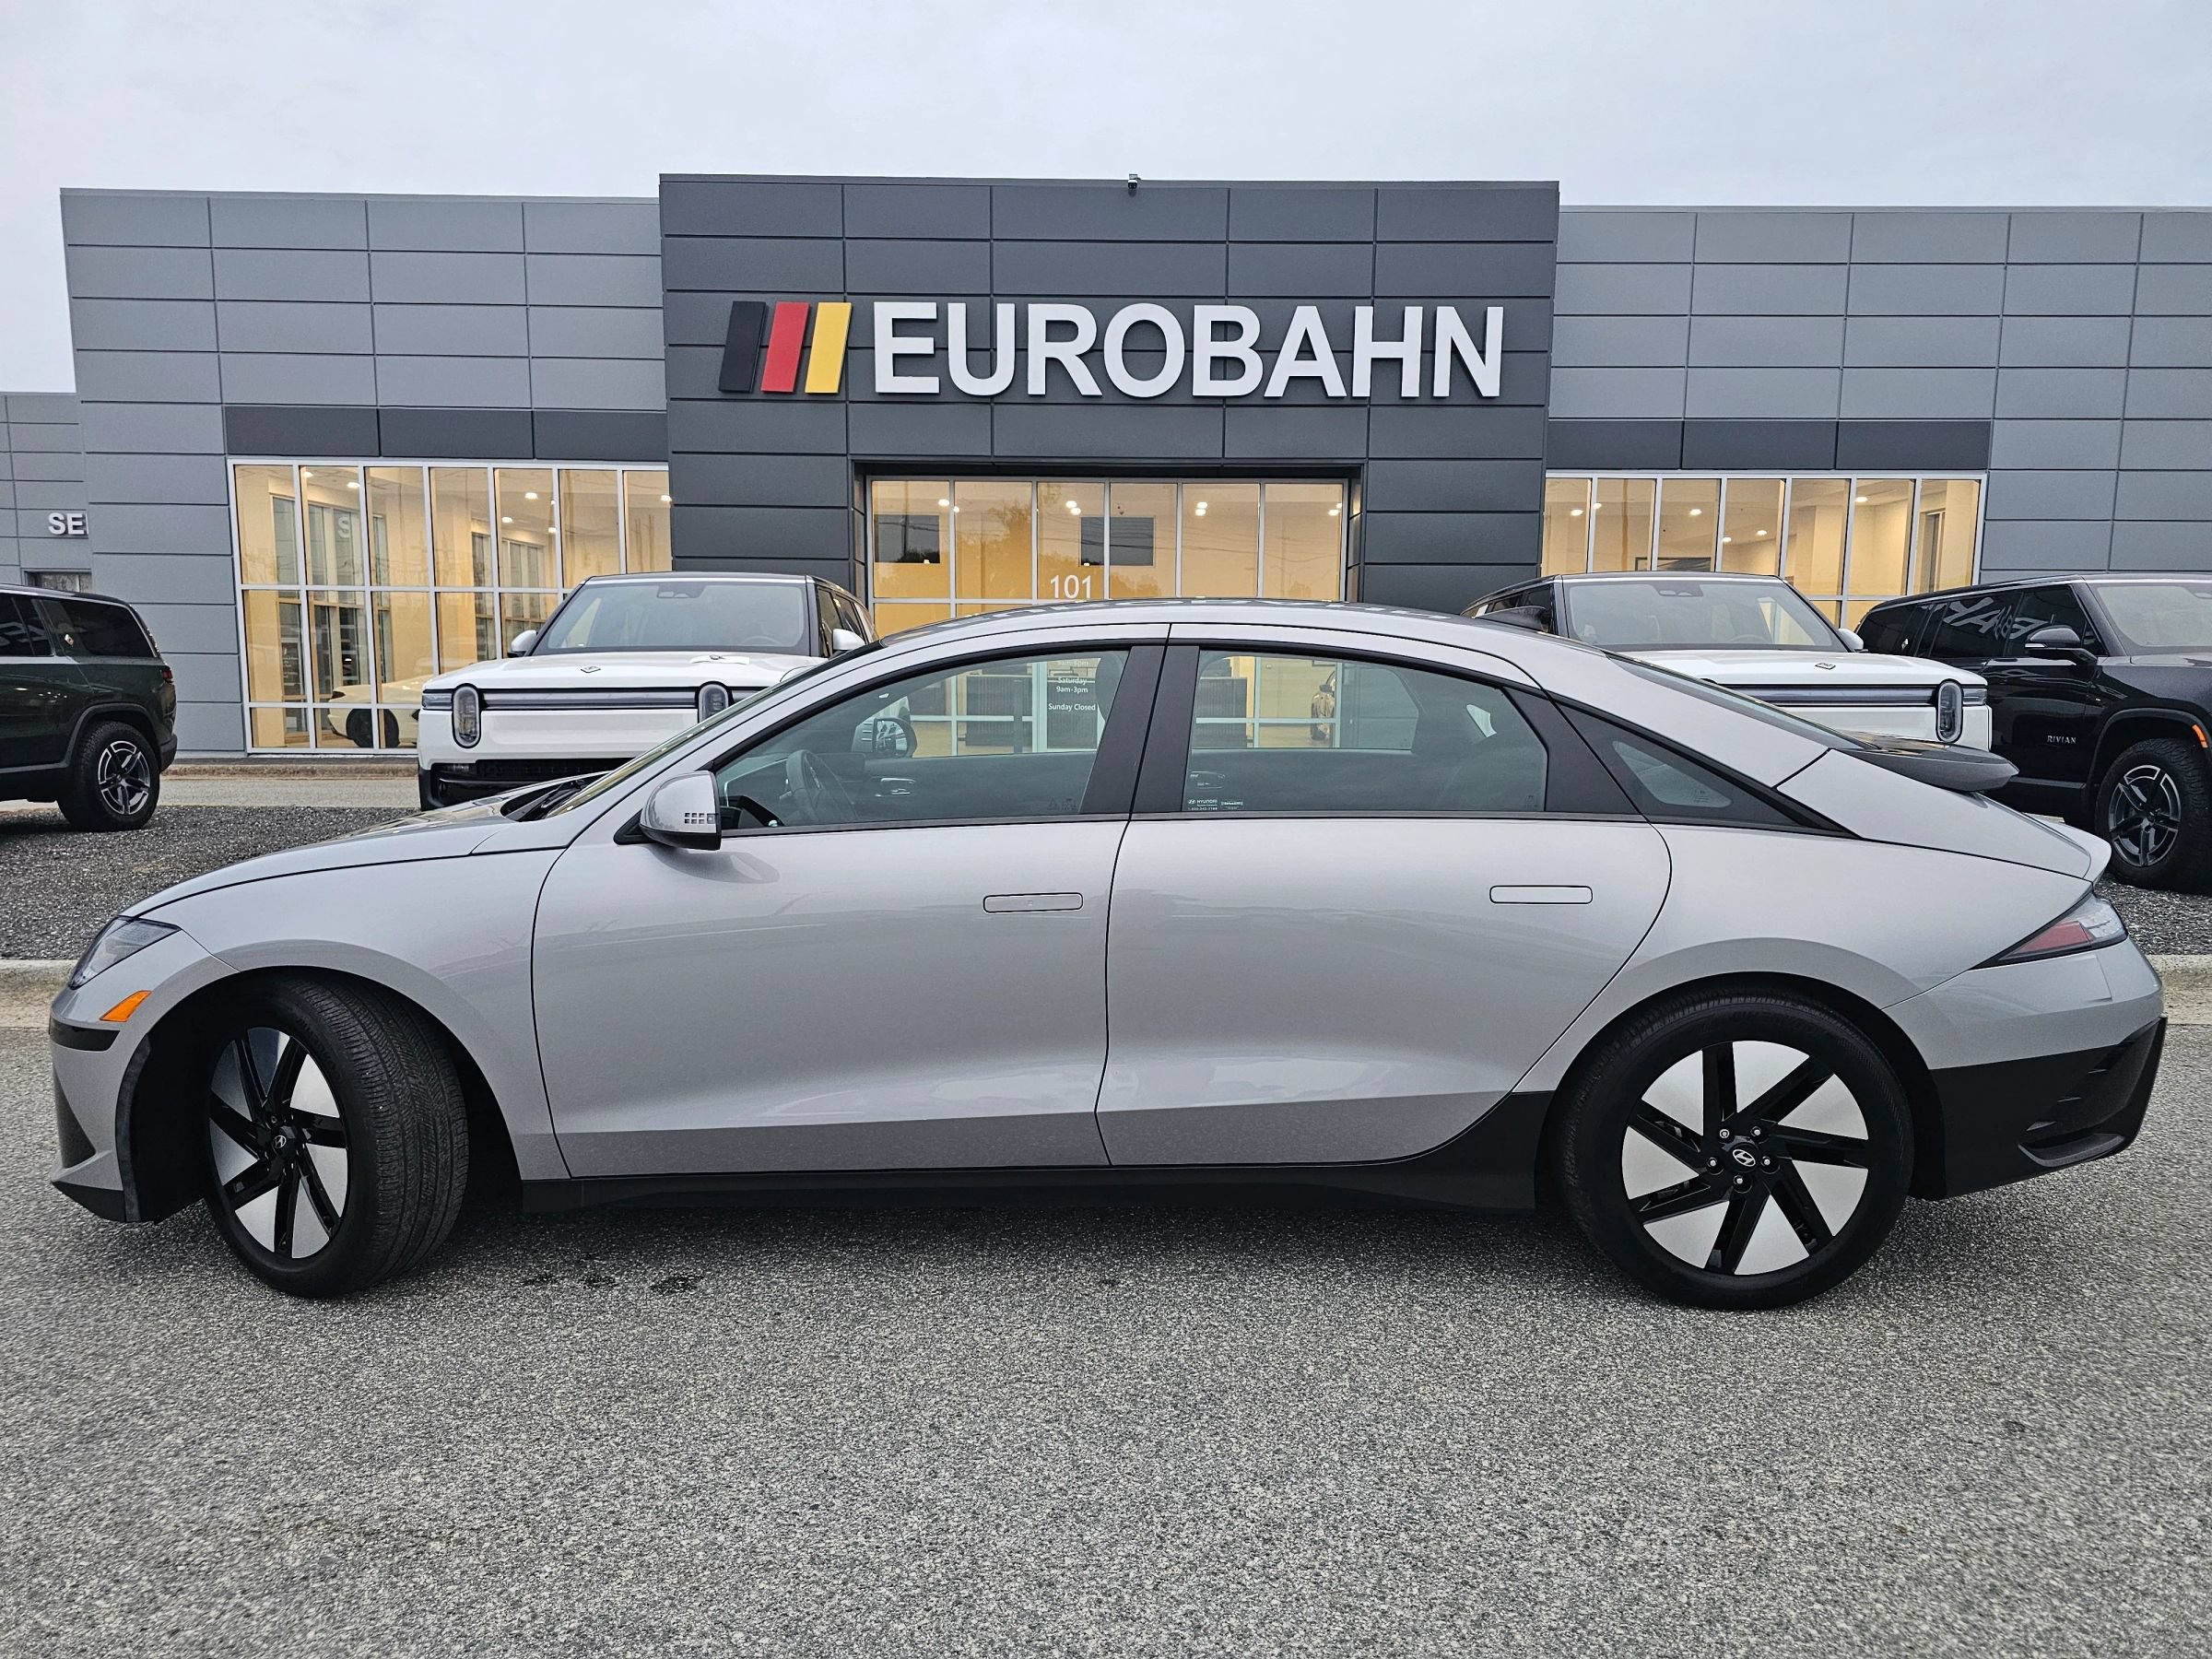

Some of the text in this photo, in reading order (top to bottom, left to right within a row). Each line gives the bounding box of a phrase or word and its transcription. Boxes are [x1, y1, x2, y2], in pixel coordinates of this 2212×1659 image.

[873, 301, 1505, 399] EUROBAHN
[48, 512, 89, 535] SE
[1050, 574, 1091, 599] 101
[1057, 677, 1088, 686] Saturday
[1055, 686, 1088, 694] 9am-3pm
[1048, 703, 1096, 712] Sunday Closed
[2047, 735, 2077, 745] RIVIAN
